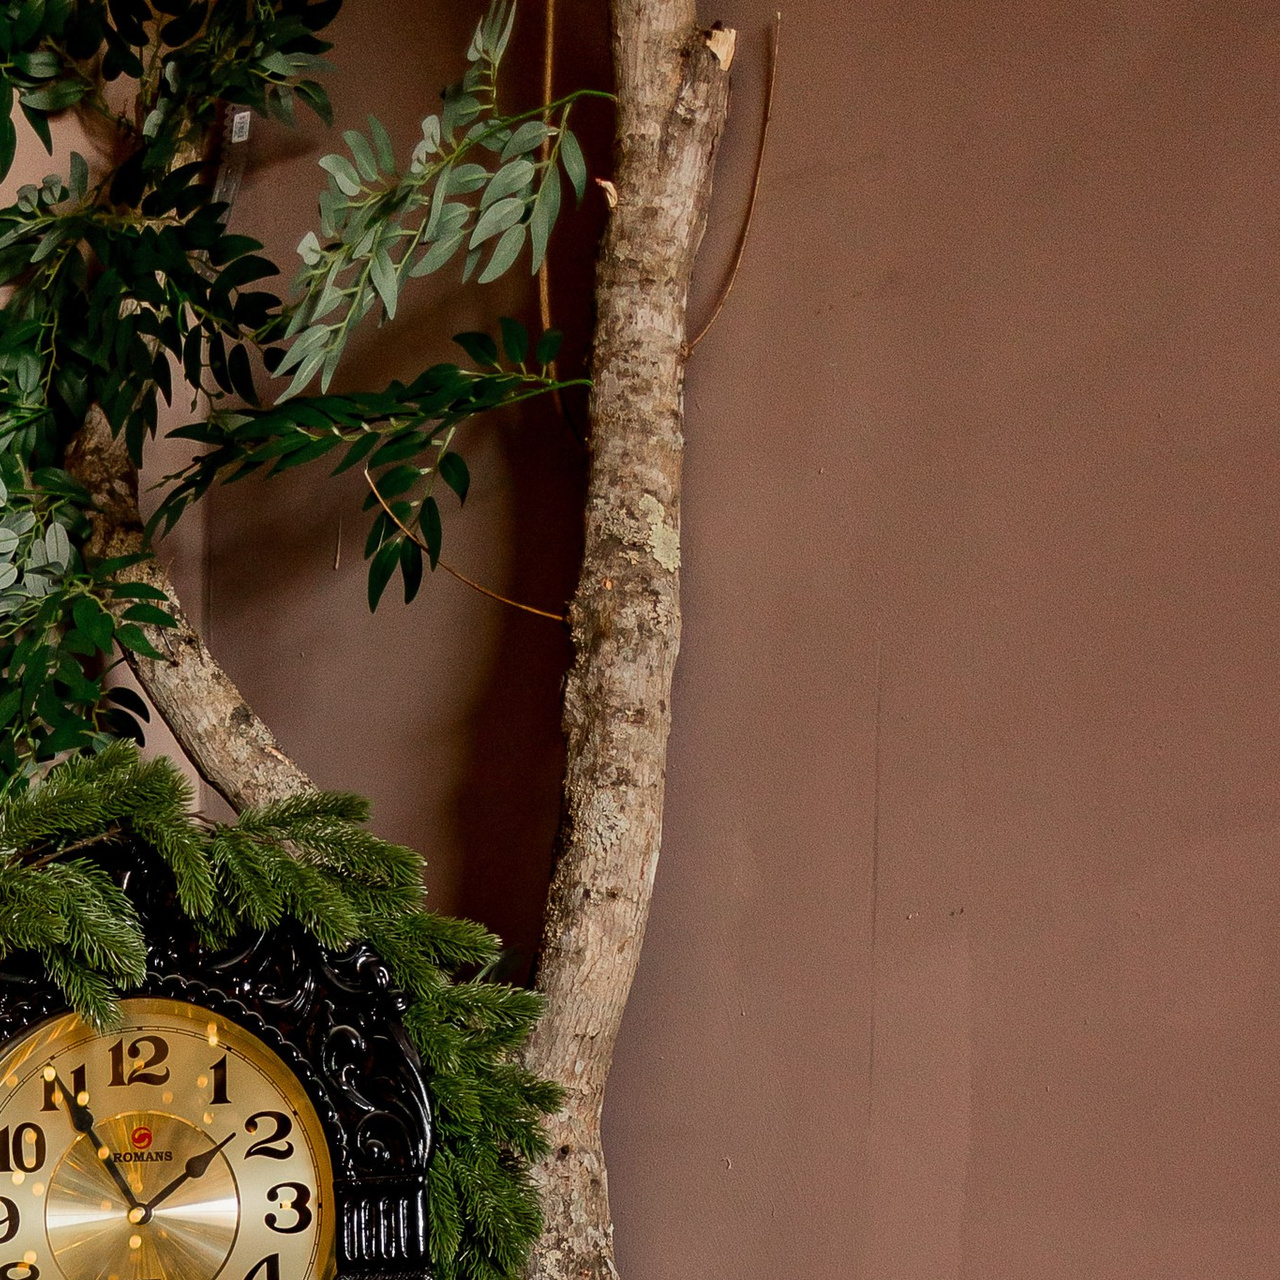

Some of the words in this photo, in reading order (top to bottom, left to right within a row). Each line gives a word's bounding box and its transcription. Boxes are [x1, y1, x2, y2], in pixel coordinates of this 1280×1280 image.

[107, 1035, 170, 1088] 12
[209, 1055, 232, 1105] 1
[39, 1063, 90, 1112] 11
[113, 1150, 173, 1163] ROMANS
[243, 1110, 295, 1161] 2
[264, 1181, 312, 1234] 3
